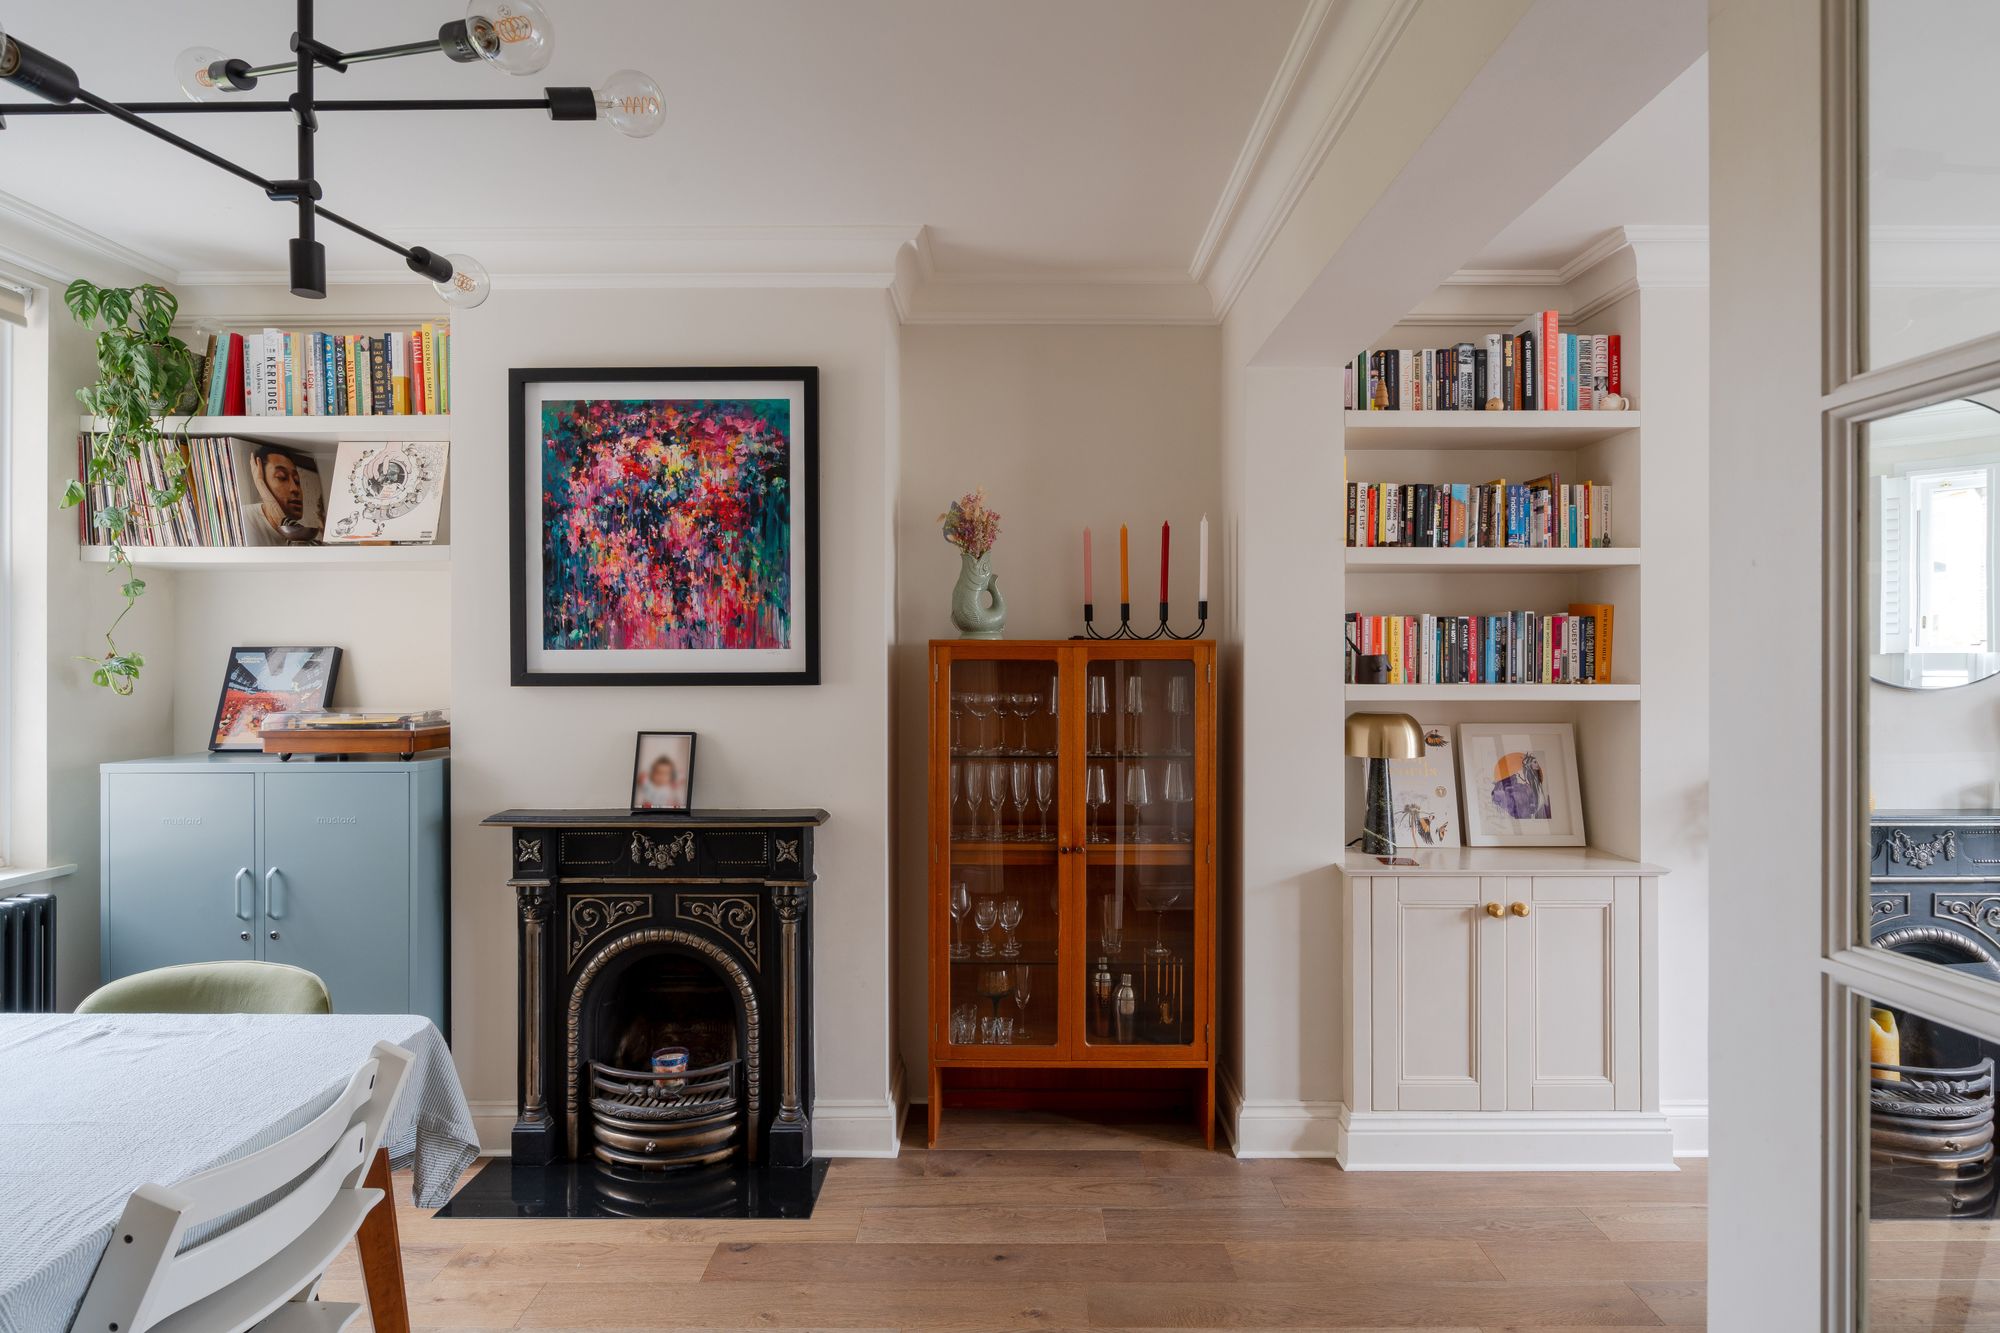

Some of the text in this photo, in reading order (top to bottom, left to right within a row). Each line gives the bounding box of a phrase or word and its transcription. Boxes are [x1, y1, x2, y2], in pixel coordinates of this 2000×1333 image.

[413, 336, 423, 364] THALI
[1579, 339, 1592, 361] CHARLIE
[1595, 337, 1607, 375] ROBIN
[284, 355, 293, 377] INDIA
[307, 370, 315, 389] LEON
[325, 353, 334, 404] FEASTS
[336, 347, 344, 384] ZAITOUN
[1579, 361, 1592, 387] KAUFMAN
[267, 356, 277, 412] KERRIDGE
[347, 360, 356, 400] KHAZANA
[316, 815, 356, 825] mustard
